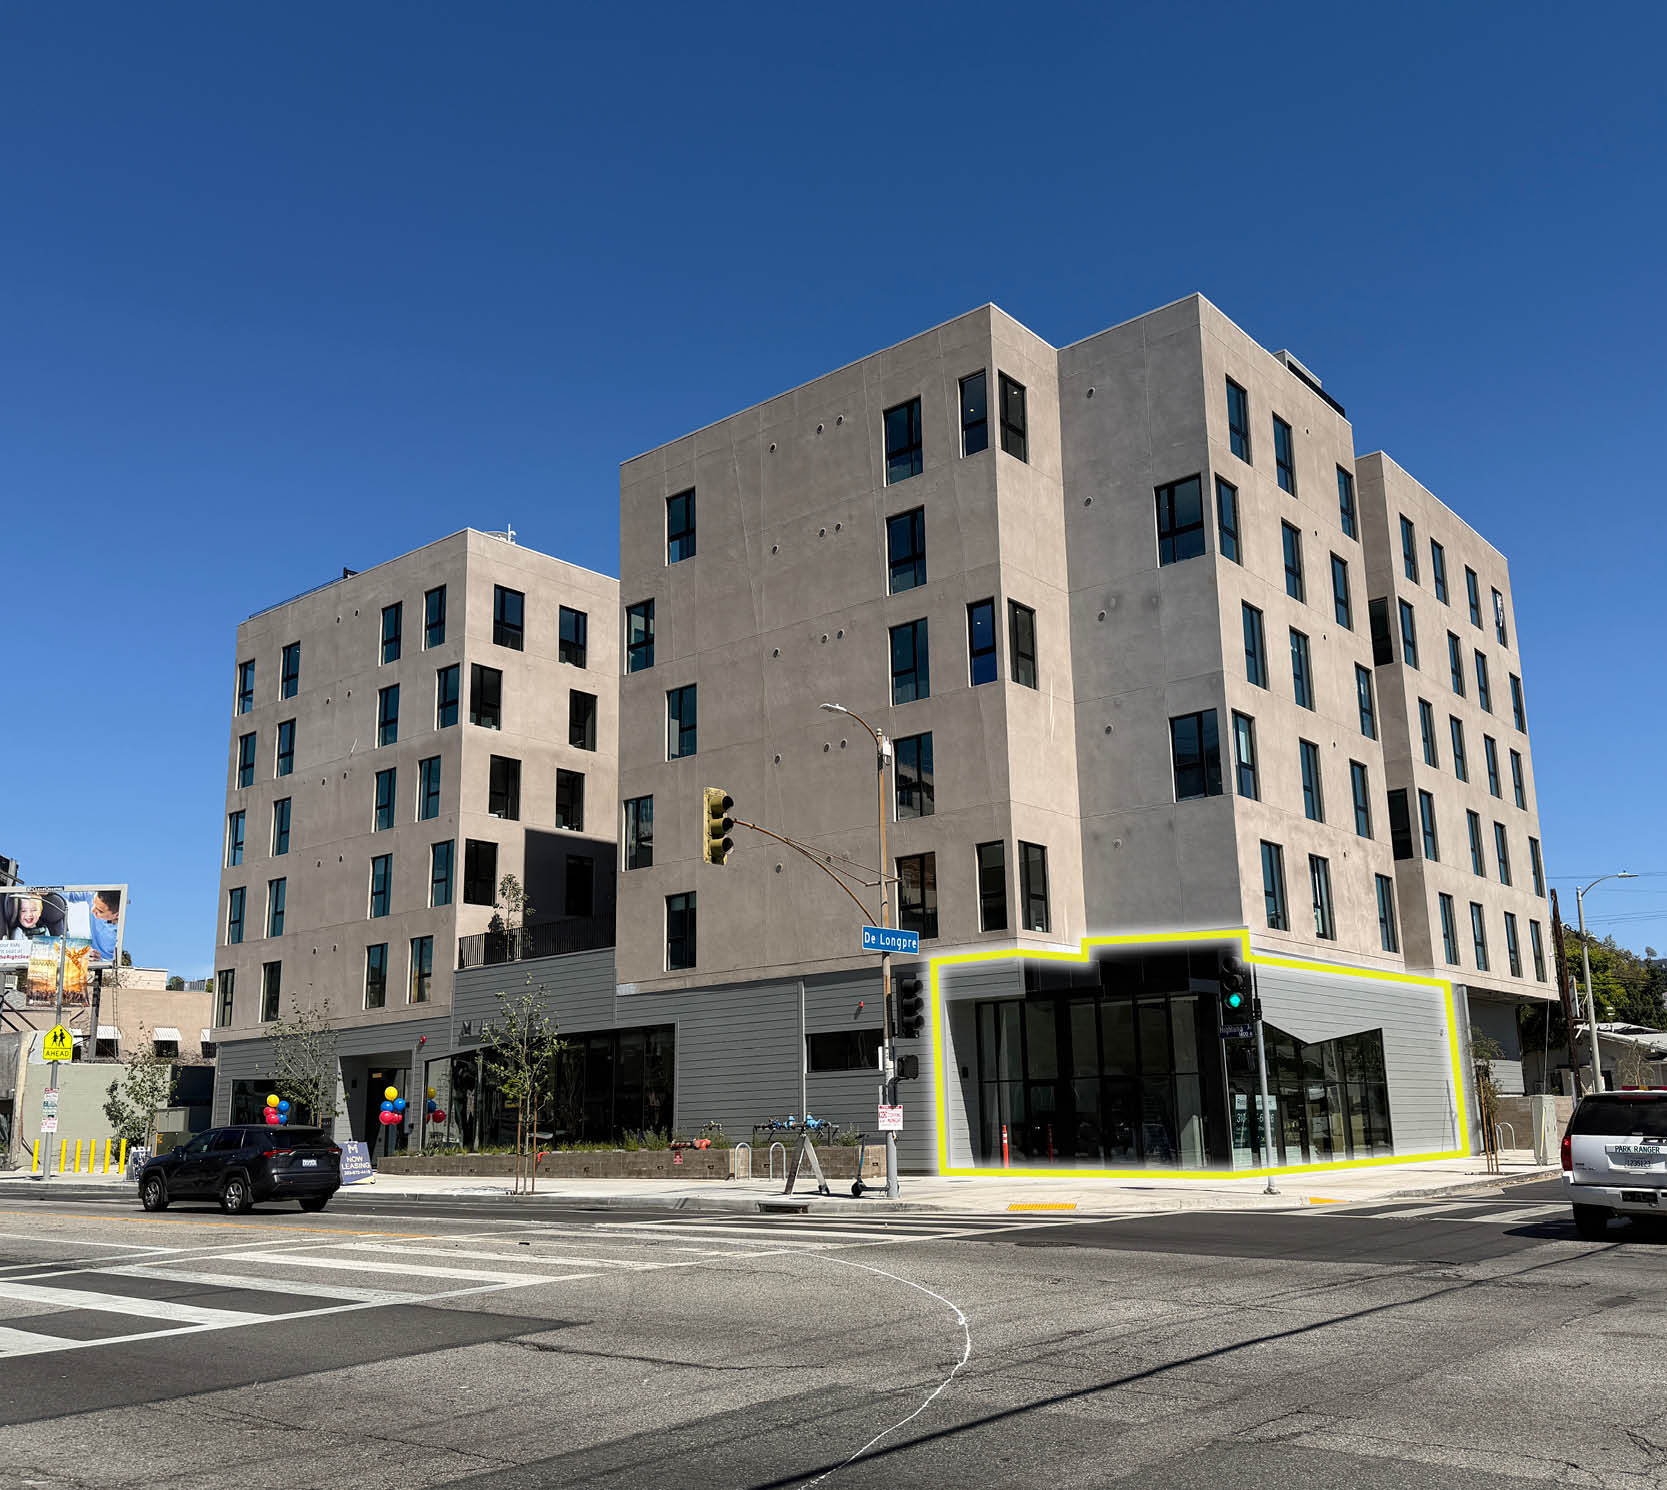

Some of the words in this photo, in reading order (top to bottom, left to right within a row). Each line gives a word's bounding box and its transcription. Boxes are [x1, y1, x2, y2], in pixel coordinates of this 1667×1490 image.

[864, 932, 876, 944] De
[879, 933, 917, 951] Longpre
[1614, 1145, 1632, 1153] PARK
[1633, 1145, 1660, 1155] RANGER
[346, 1155, 363, 1163] NOW
[341, 1161, 371, 1170] LEASING
